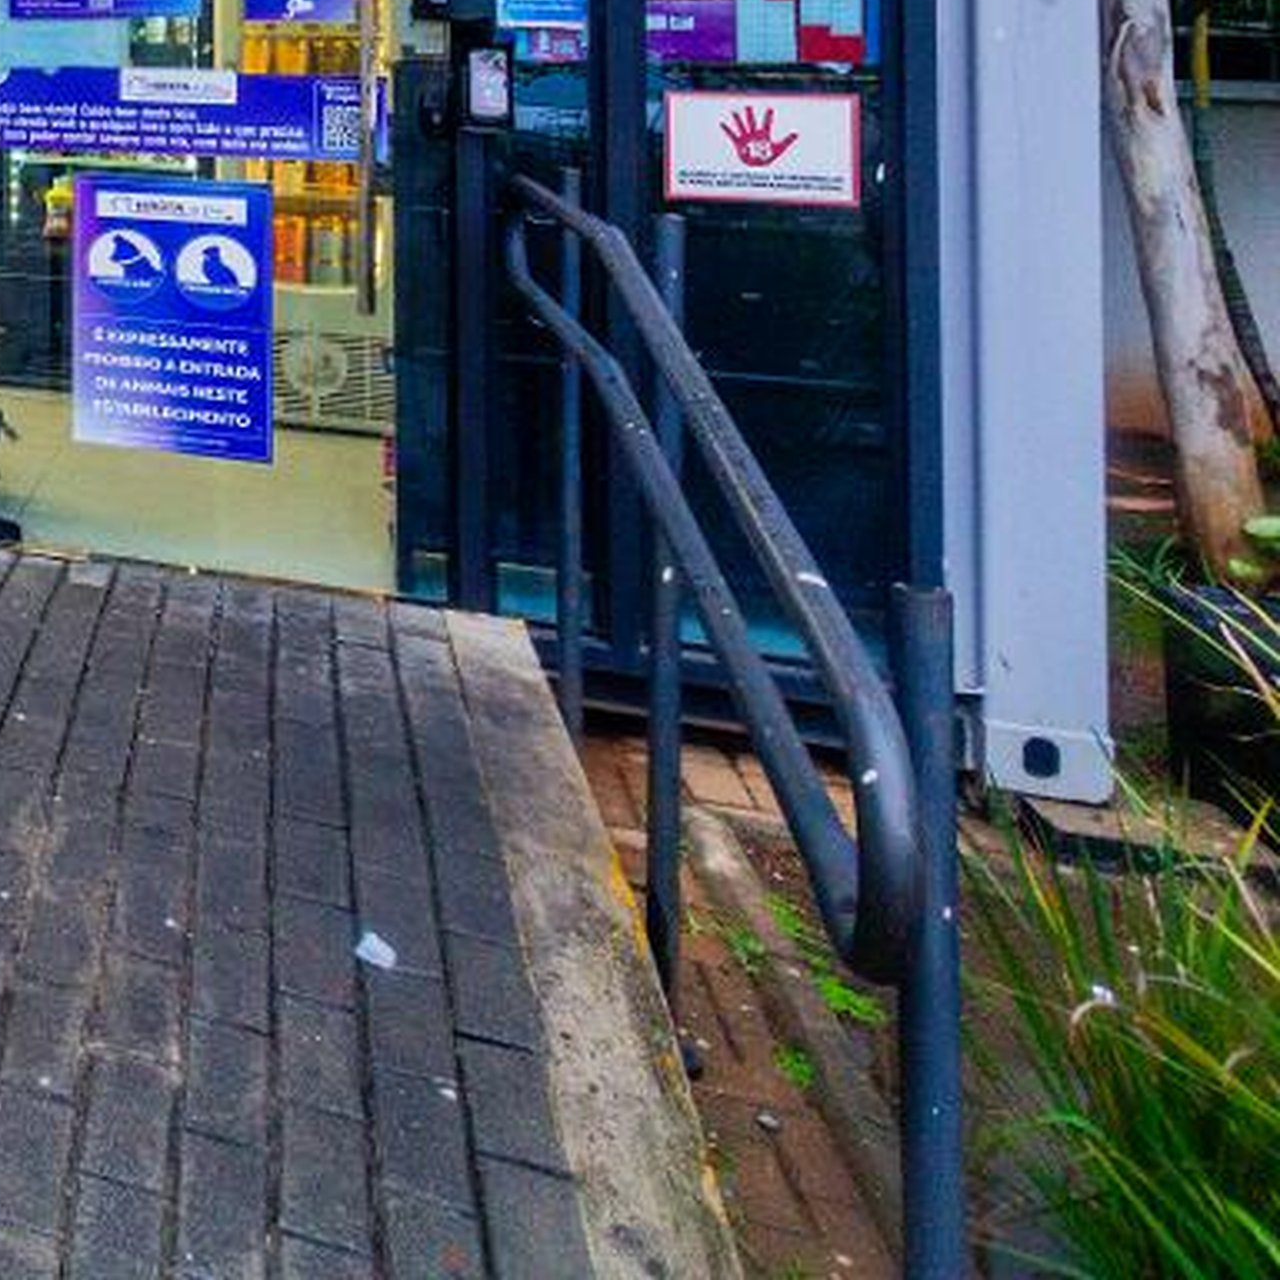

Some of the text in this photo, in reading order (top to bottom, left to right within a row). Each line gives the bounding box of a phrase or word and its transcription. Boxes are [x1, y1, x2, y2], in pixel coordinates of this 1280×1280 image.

[105, 328, 251, 358] EXPRESSAMENTE
[164, 357, 177, 371] A
[179, 360, 261, 382] ENTRADA
[192, 384, 249, 405] NESTE
